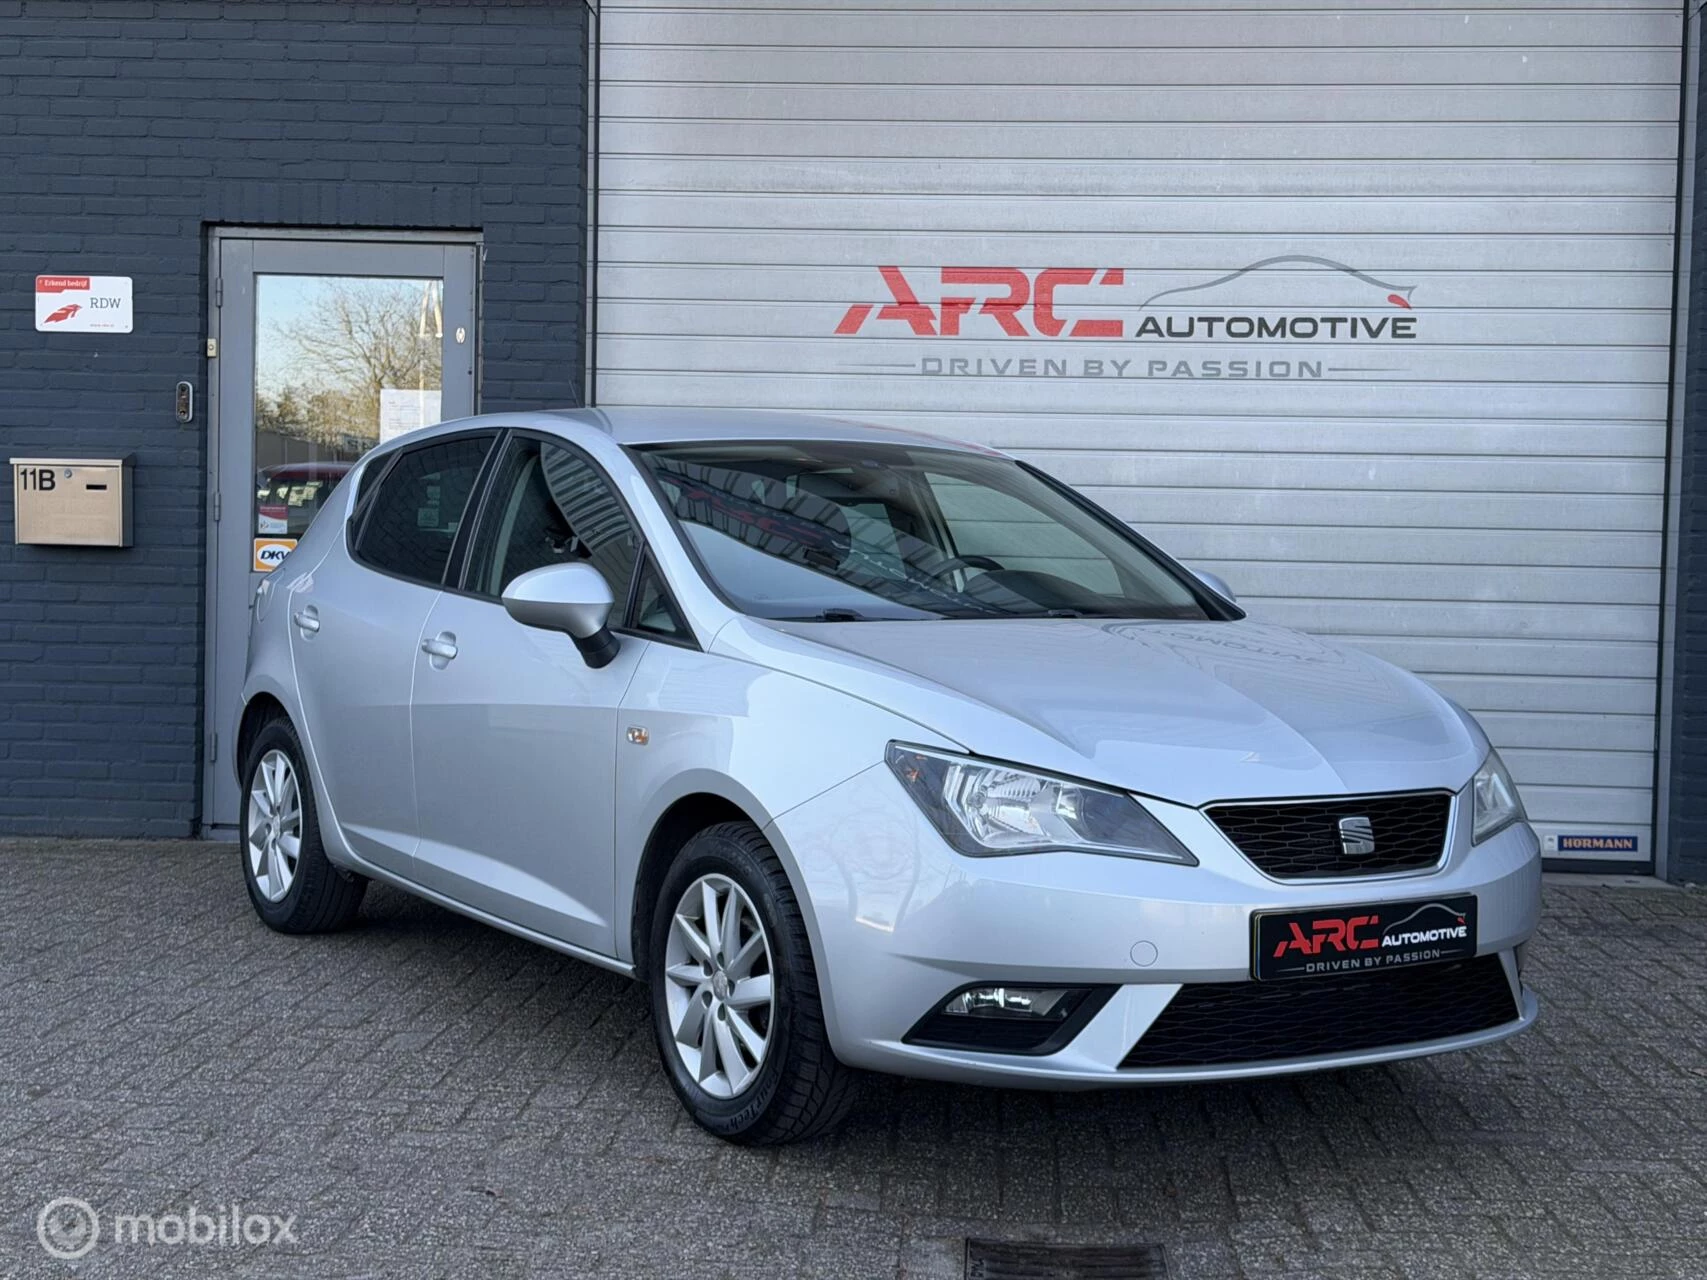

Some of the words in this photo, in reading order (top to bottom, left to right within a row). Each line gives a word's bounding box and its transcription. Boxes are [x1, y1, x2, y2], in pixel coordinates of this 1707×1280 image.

[90, 297, 121, 309] RDW
[833, 266, 1124, 338] ARC
[1134, 316, 1417, 339] AUTOMOTIVE
[920, 357, 1069, 378] DRIVEN
[1083, 358, 1131, 378] BY
[1147, 358, 1323, 379] PASSION
[19, 468, 56, 491] 11B
[1273, 915, 1379, 957] ARC
[1381, 925, 1467, 947] AUTOMOTIVE
[1305, 959, 1360, 973] DRIVEN
[1364, 957, 1381, 967] BY
[1385, 948, 1441, 965] PASSION
